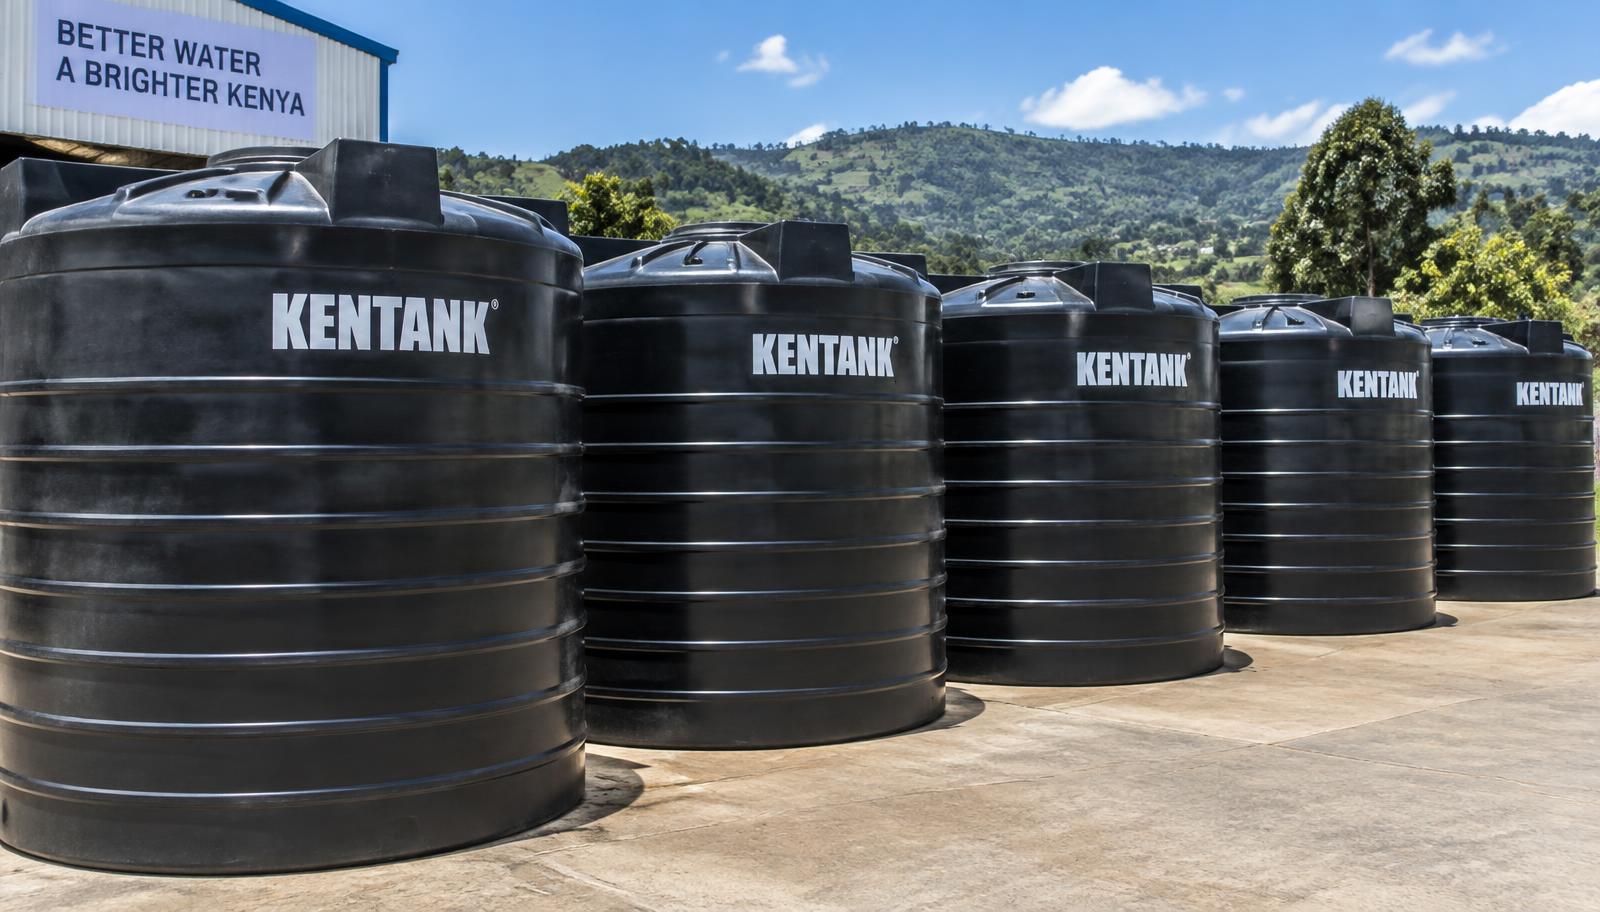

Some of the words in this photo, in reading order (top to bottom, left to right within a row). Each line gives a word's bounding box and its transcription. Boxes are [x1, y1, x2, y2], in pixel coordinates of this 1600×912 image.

[57, 19, 165, 61] BETTER
[174, 38, 262, 77] WATER
[56, 56, 76, 83] A
[85, 60, 219, 104] BRIGHTER
[227, 82, 306, 117] KENYA
[1516, 381, 1584, 407] KENTANK
